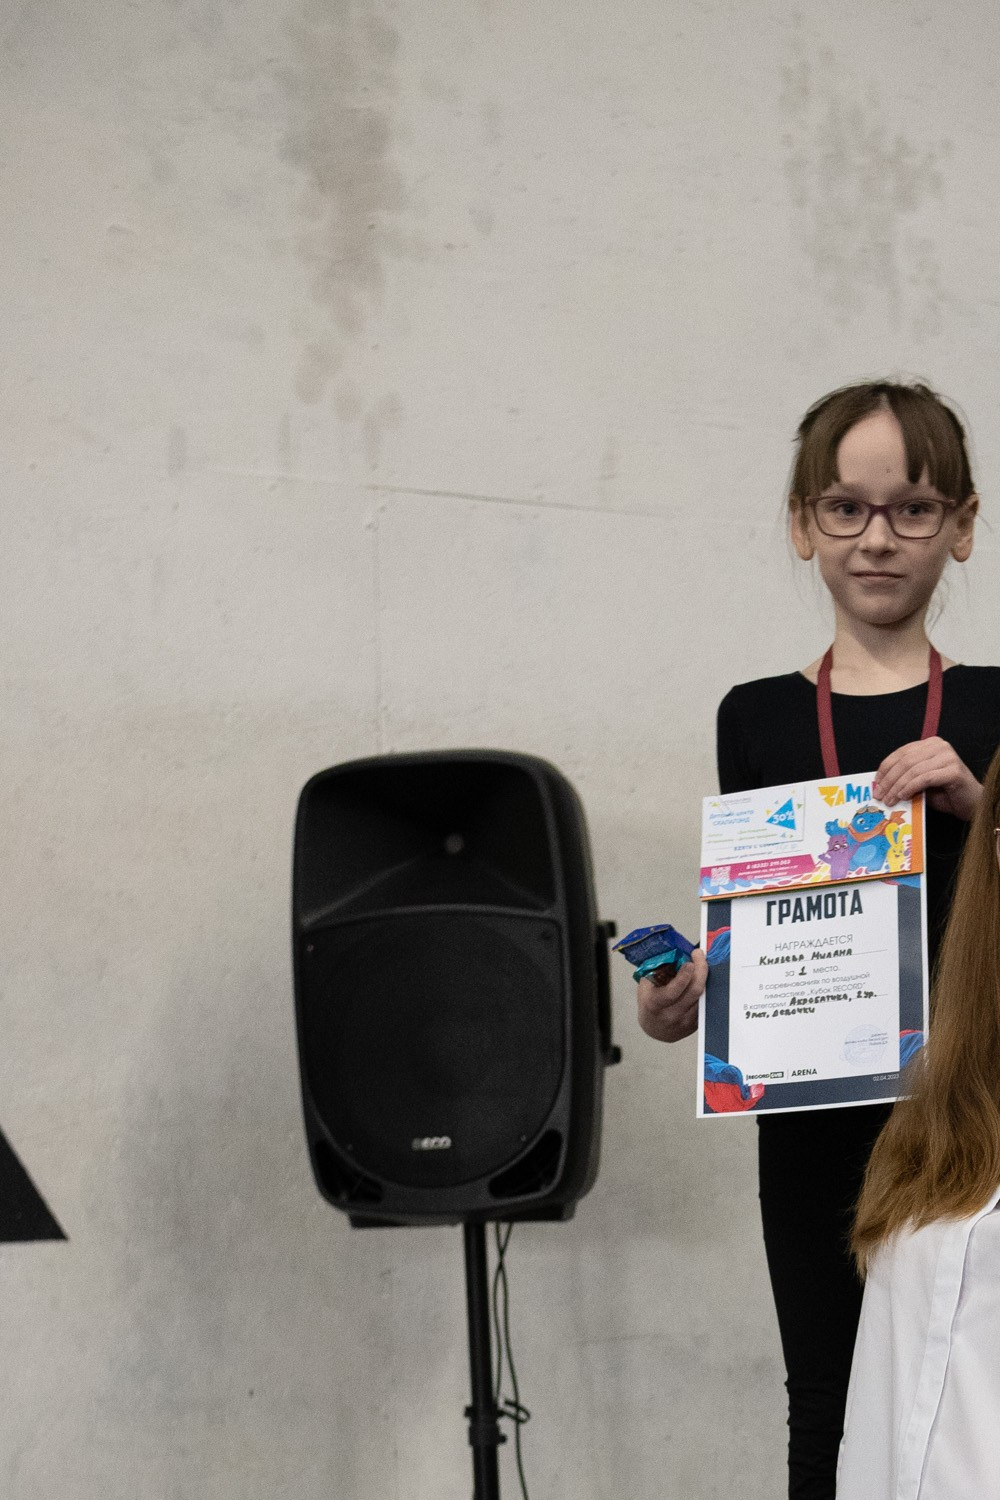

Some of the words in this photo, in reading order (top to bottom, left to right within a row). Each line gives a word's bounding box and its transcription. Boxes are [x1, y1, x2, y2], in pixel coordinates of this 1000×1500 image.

[766, 889, 863, 926] ГРАМОТА
[774, 934, 854, 952] НАГРАЖДАЕТСЯ
[785, 970, 795, 978] за
[798, 966, 807, 976] 1
[791, 1068, 818, 1077] ARENA
